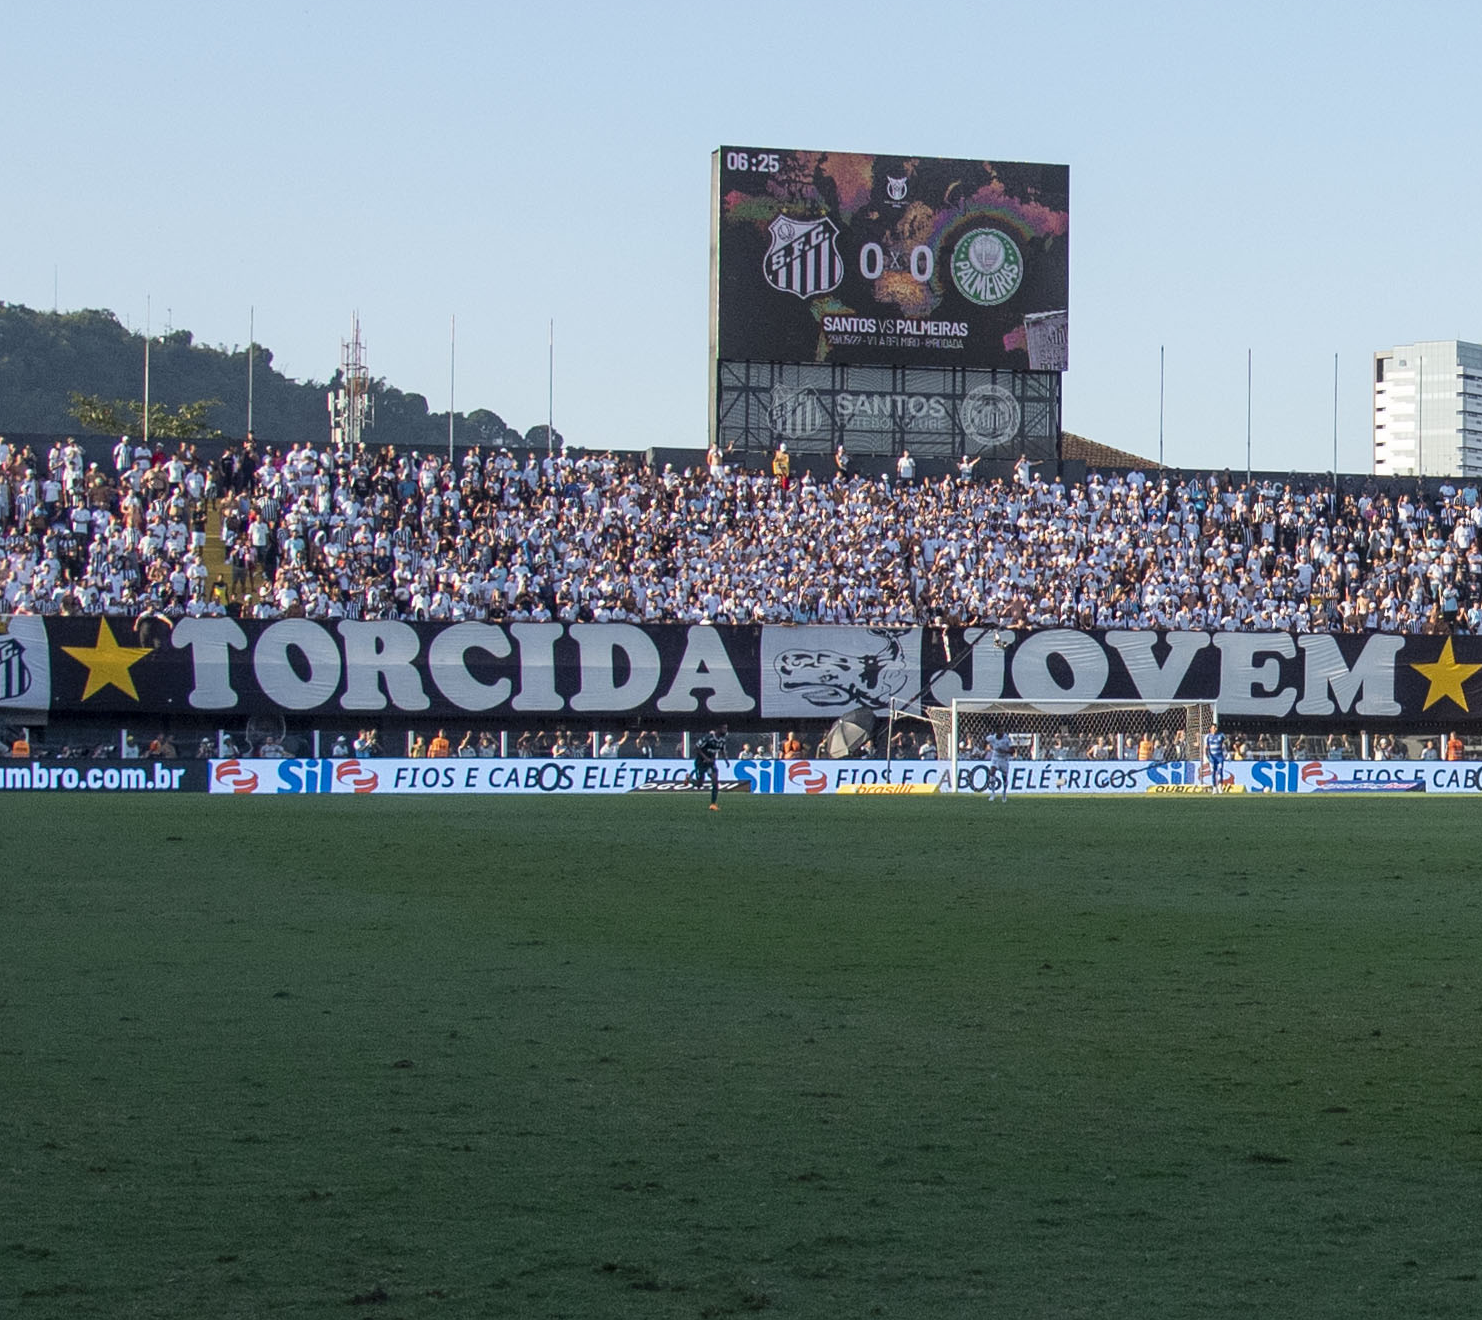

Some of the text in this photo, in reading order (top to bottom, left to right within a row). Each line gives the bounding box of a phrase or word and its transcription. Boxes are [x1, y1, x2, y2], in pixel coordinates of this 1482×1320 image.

[727, 152, 779, 172] 06:25
[860, 242, 883, 279] 0
[910, 245, 934, 282] 0
[954, 261, 1018, 300] PALMEIRAS
[823, 316, 968, 337] SANTOS VS PALMEIRAS
[837, 393, 946, 418] SANTOS
[171, 617, 756, 712] TORCIDA
[930, 627, 1406, 717] JOVEM
[277, 759, 333, 793] Sil
[394, 762, 710, 791] FIOS E CABOS ELÉTRIC
[734, 760, 786, 793] Sil
[836, 768, 890, 788] FIOS
[1011, 764, 1138, 791] ELÉTRICOS
[858, 783, 915, 794] brasilit
[1251, 761, 1299, 793] Sil
